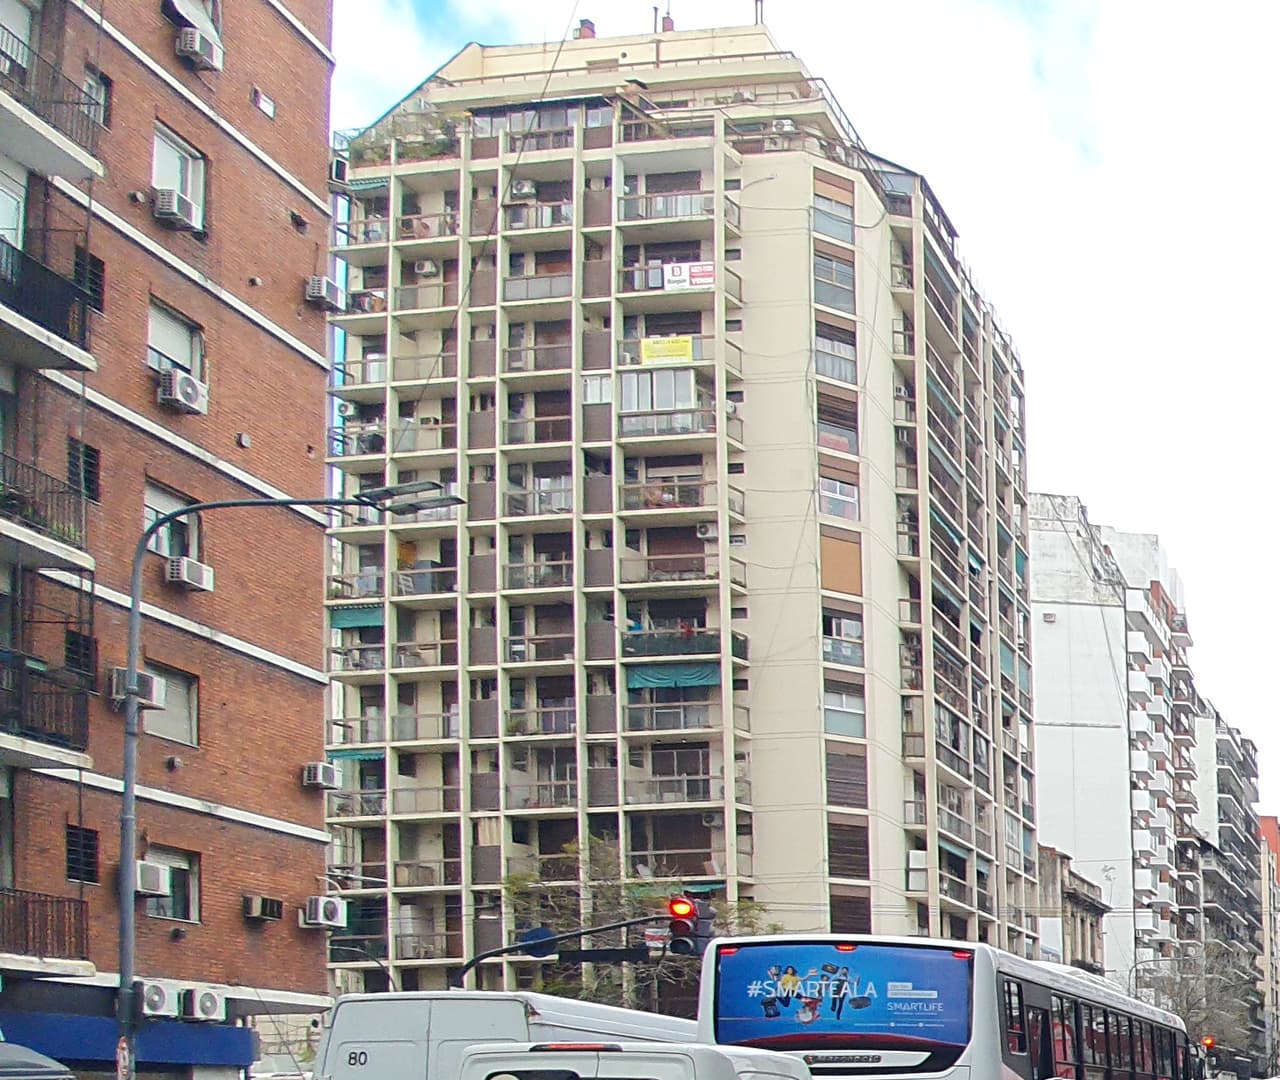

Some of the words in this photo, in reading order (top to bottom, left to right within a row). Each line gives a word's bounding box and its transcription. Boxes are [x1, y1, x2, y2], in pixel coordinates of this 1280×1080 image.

[747, 979, 878, 999] #SMARTEALA
[887, 1002, 944, 1012] SMARTLIFE
[348, 1051, 368, 1066] 80
